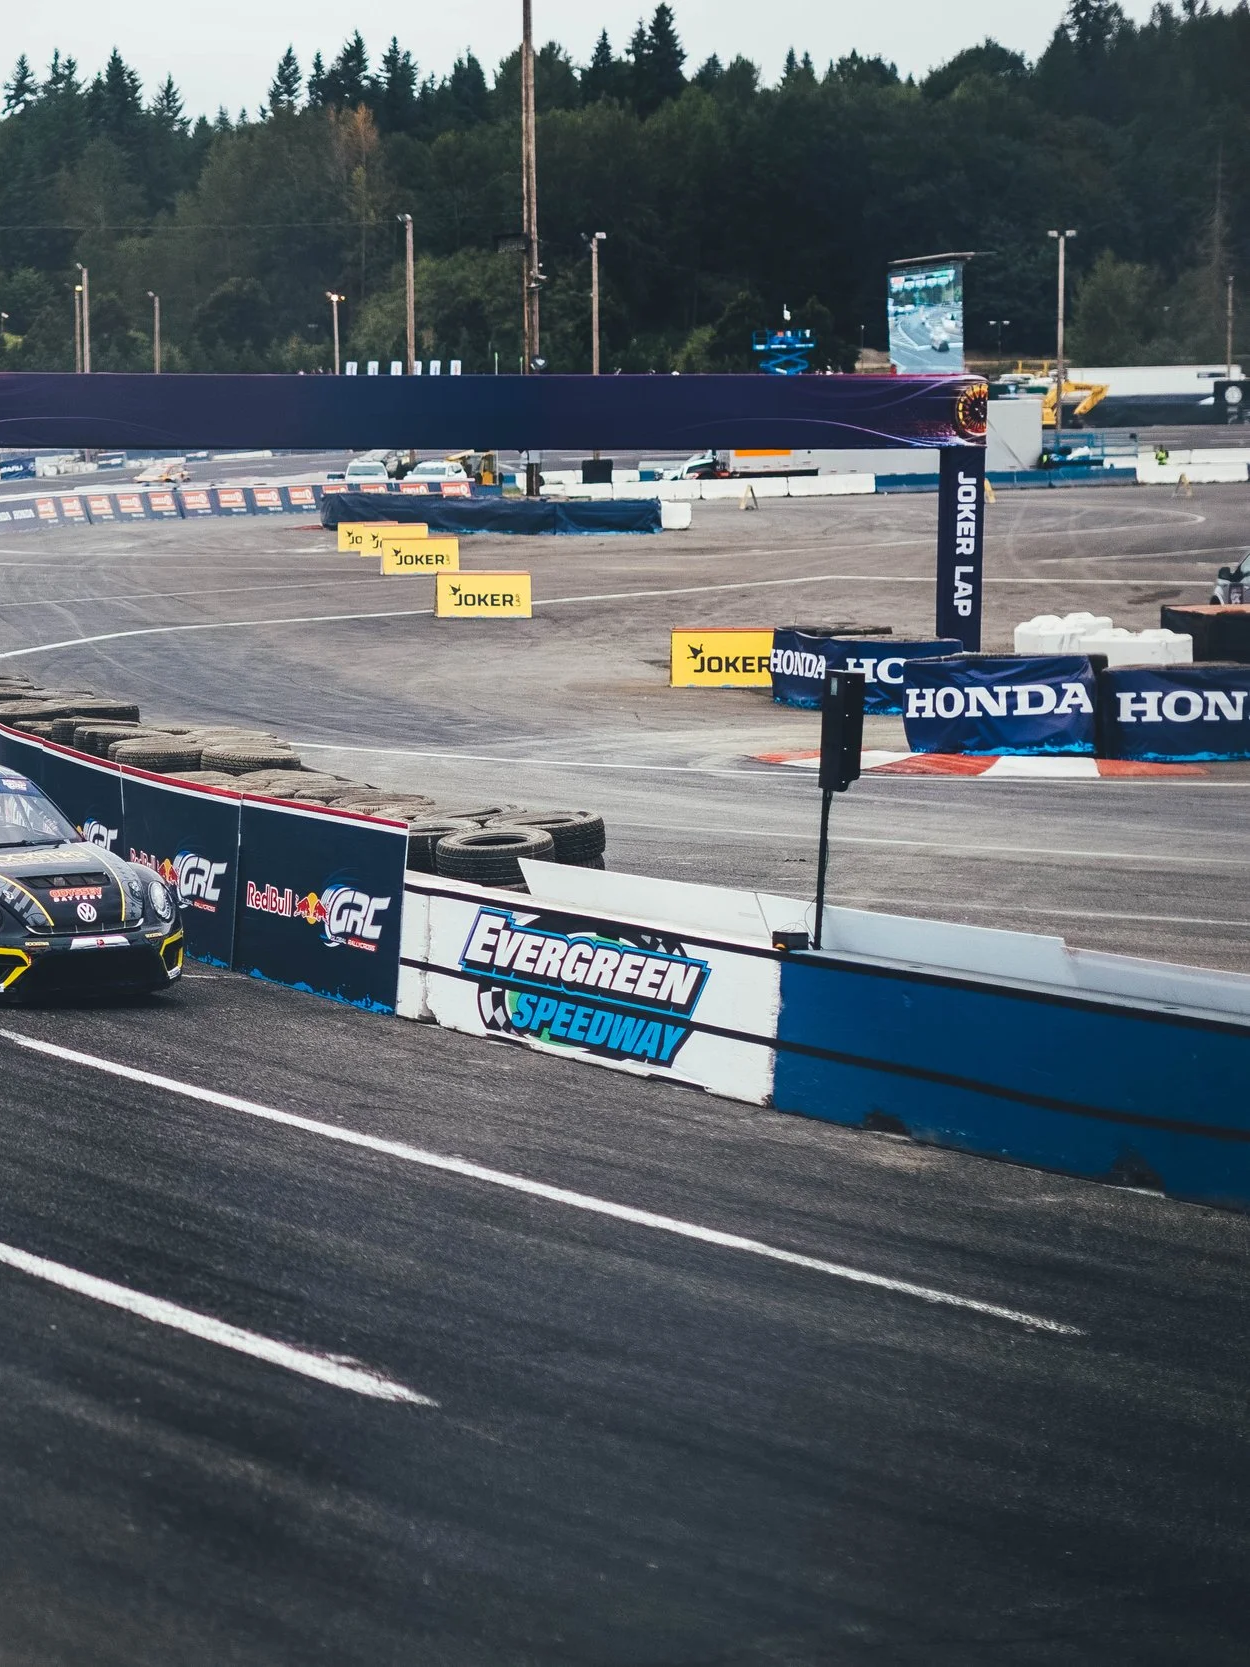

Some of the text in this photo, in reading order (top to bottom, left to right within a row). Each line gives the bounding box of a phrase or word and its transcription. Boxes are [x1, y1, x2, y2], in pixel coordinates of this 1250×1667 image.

[954, 472, 976, 616] JOKER LAP
[396, 555, 444, 566] JOKER
[454, 593, 514, 606] JOKER
[694, 656, 771, 673] JOKER
[770, 649, 826, 680] HONDA
[905, 682, 1094, 718] HONDA
[1116, 690, 1250, 722] HON
[49, 887, 102, 898] ODYSSEY
[179, 856, 225, 902] GRC
[53, 894, 102, 902] BATTERY
[329, 889, 392, 940] GRC
[464, 912, 701, 1005] EVERGREEN
[510, 992, 687, 1062] SPEEDWAY
